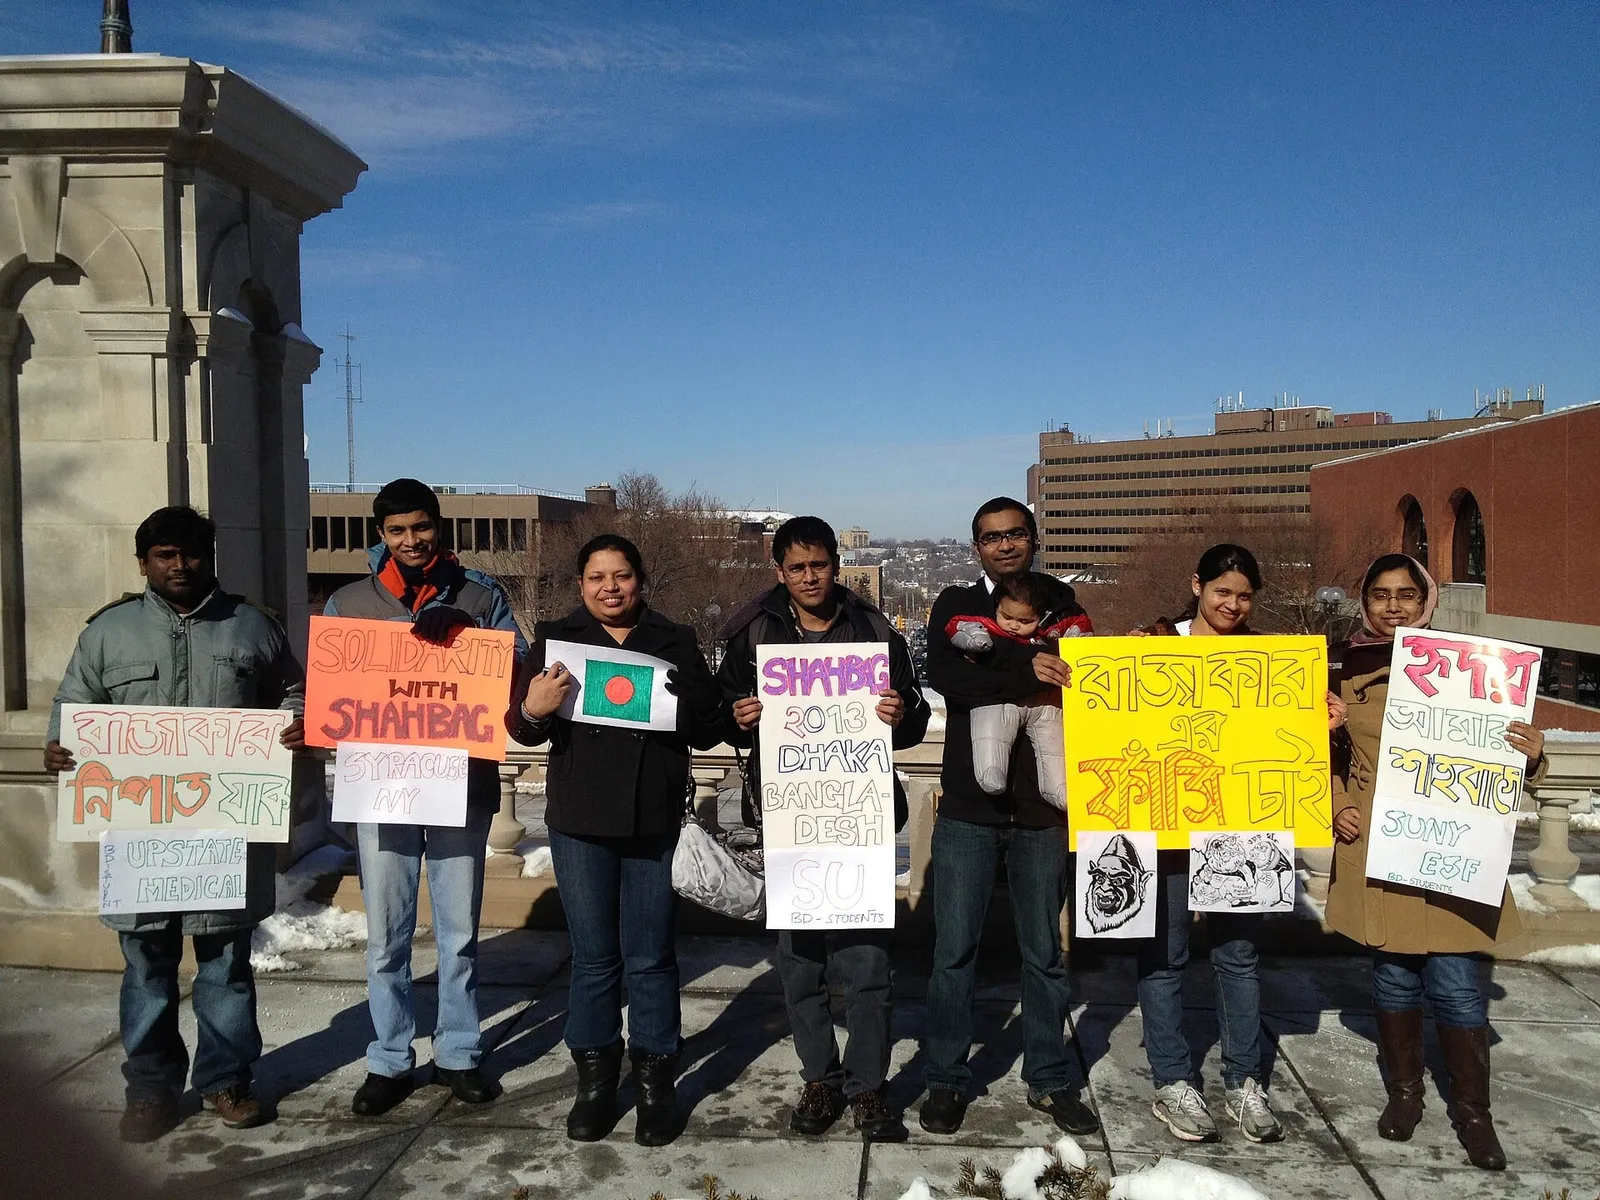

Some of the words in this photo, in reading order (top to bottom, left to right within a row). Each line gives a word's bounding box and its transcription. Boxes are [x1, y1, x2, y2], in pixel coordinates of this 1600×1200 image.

[388, 678, 458, 701] WITH
[762, 653, 889, 696] SHAHBAG
[1076, 647, 1321, 712] রাজাকার
[72, 710, 286, 760] রাজাকার
[320, 697, 494, 743] SHAHBAG
[784, 701, 867, 739] 2013
[1157, 710, 1228, 752] এর
[344, 751, 468, 783] SYRACUSE
[778, 738, 891, 773] DHAKA
[66, 760, 211, 825] নিপাত
[217, 772, 291, 826] যাক
[762, 779, 891, 814] BANGLA-
[1078, 738, 1226, 830] ফাঁসি
[1231, 728, 1332, 829] চাই
[373, 788, 420, 814] NY
[794, 814, 884, 847] DESH
[1381, 809, 1471, 848] SUNY
[127, 837, 244, 869] UPSTATE
[1419, 851, 1481, 882] ESF
[136, 874, 246, 903] MEDICAL
[792, 859, 865, 910] SU
